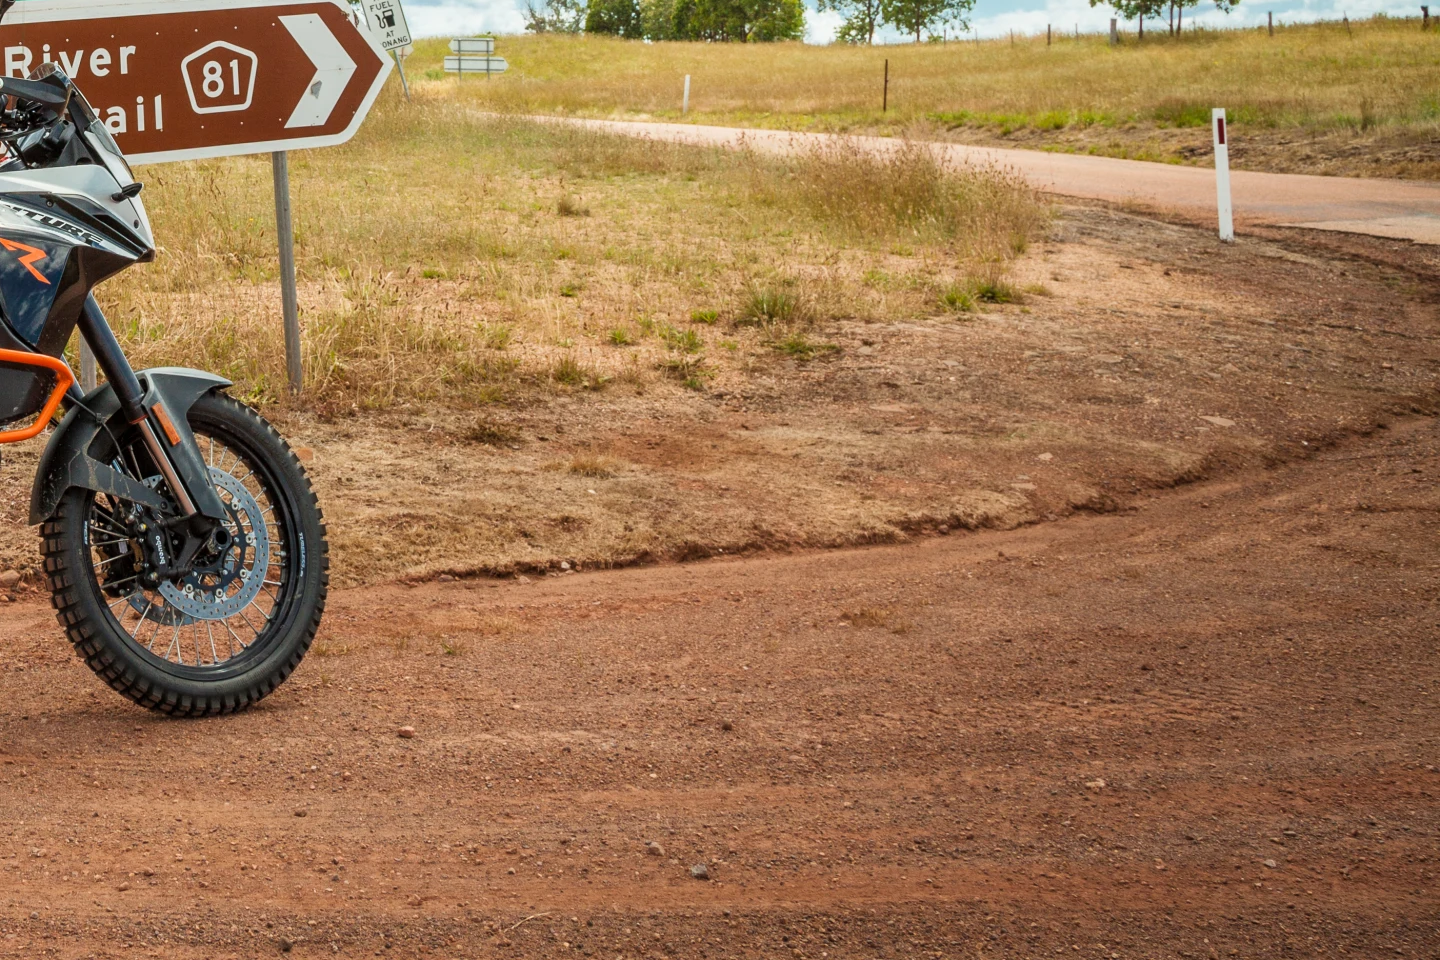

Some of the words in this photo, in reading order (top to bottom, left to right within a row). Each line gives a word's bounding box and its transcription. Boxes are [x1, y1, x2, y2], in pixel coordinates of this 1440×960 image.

[369, 1, 393, 12] FUEL
[380, 35, 408, 48] ONANG
[386, 30, 395, 38] AT
[4, 43, 136, 79] River
[202, 58, 241, 98] 81
[155, 535, 166, 565] brembo
